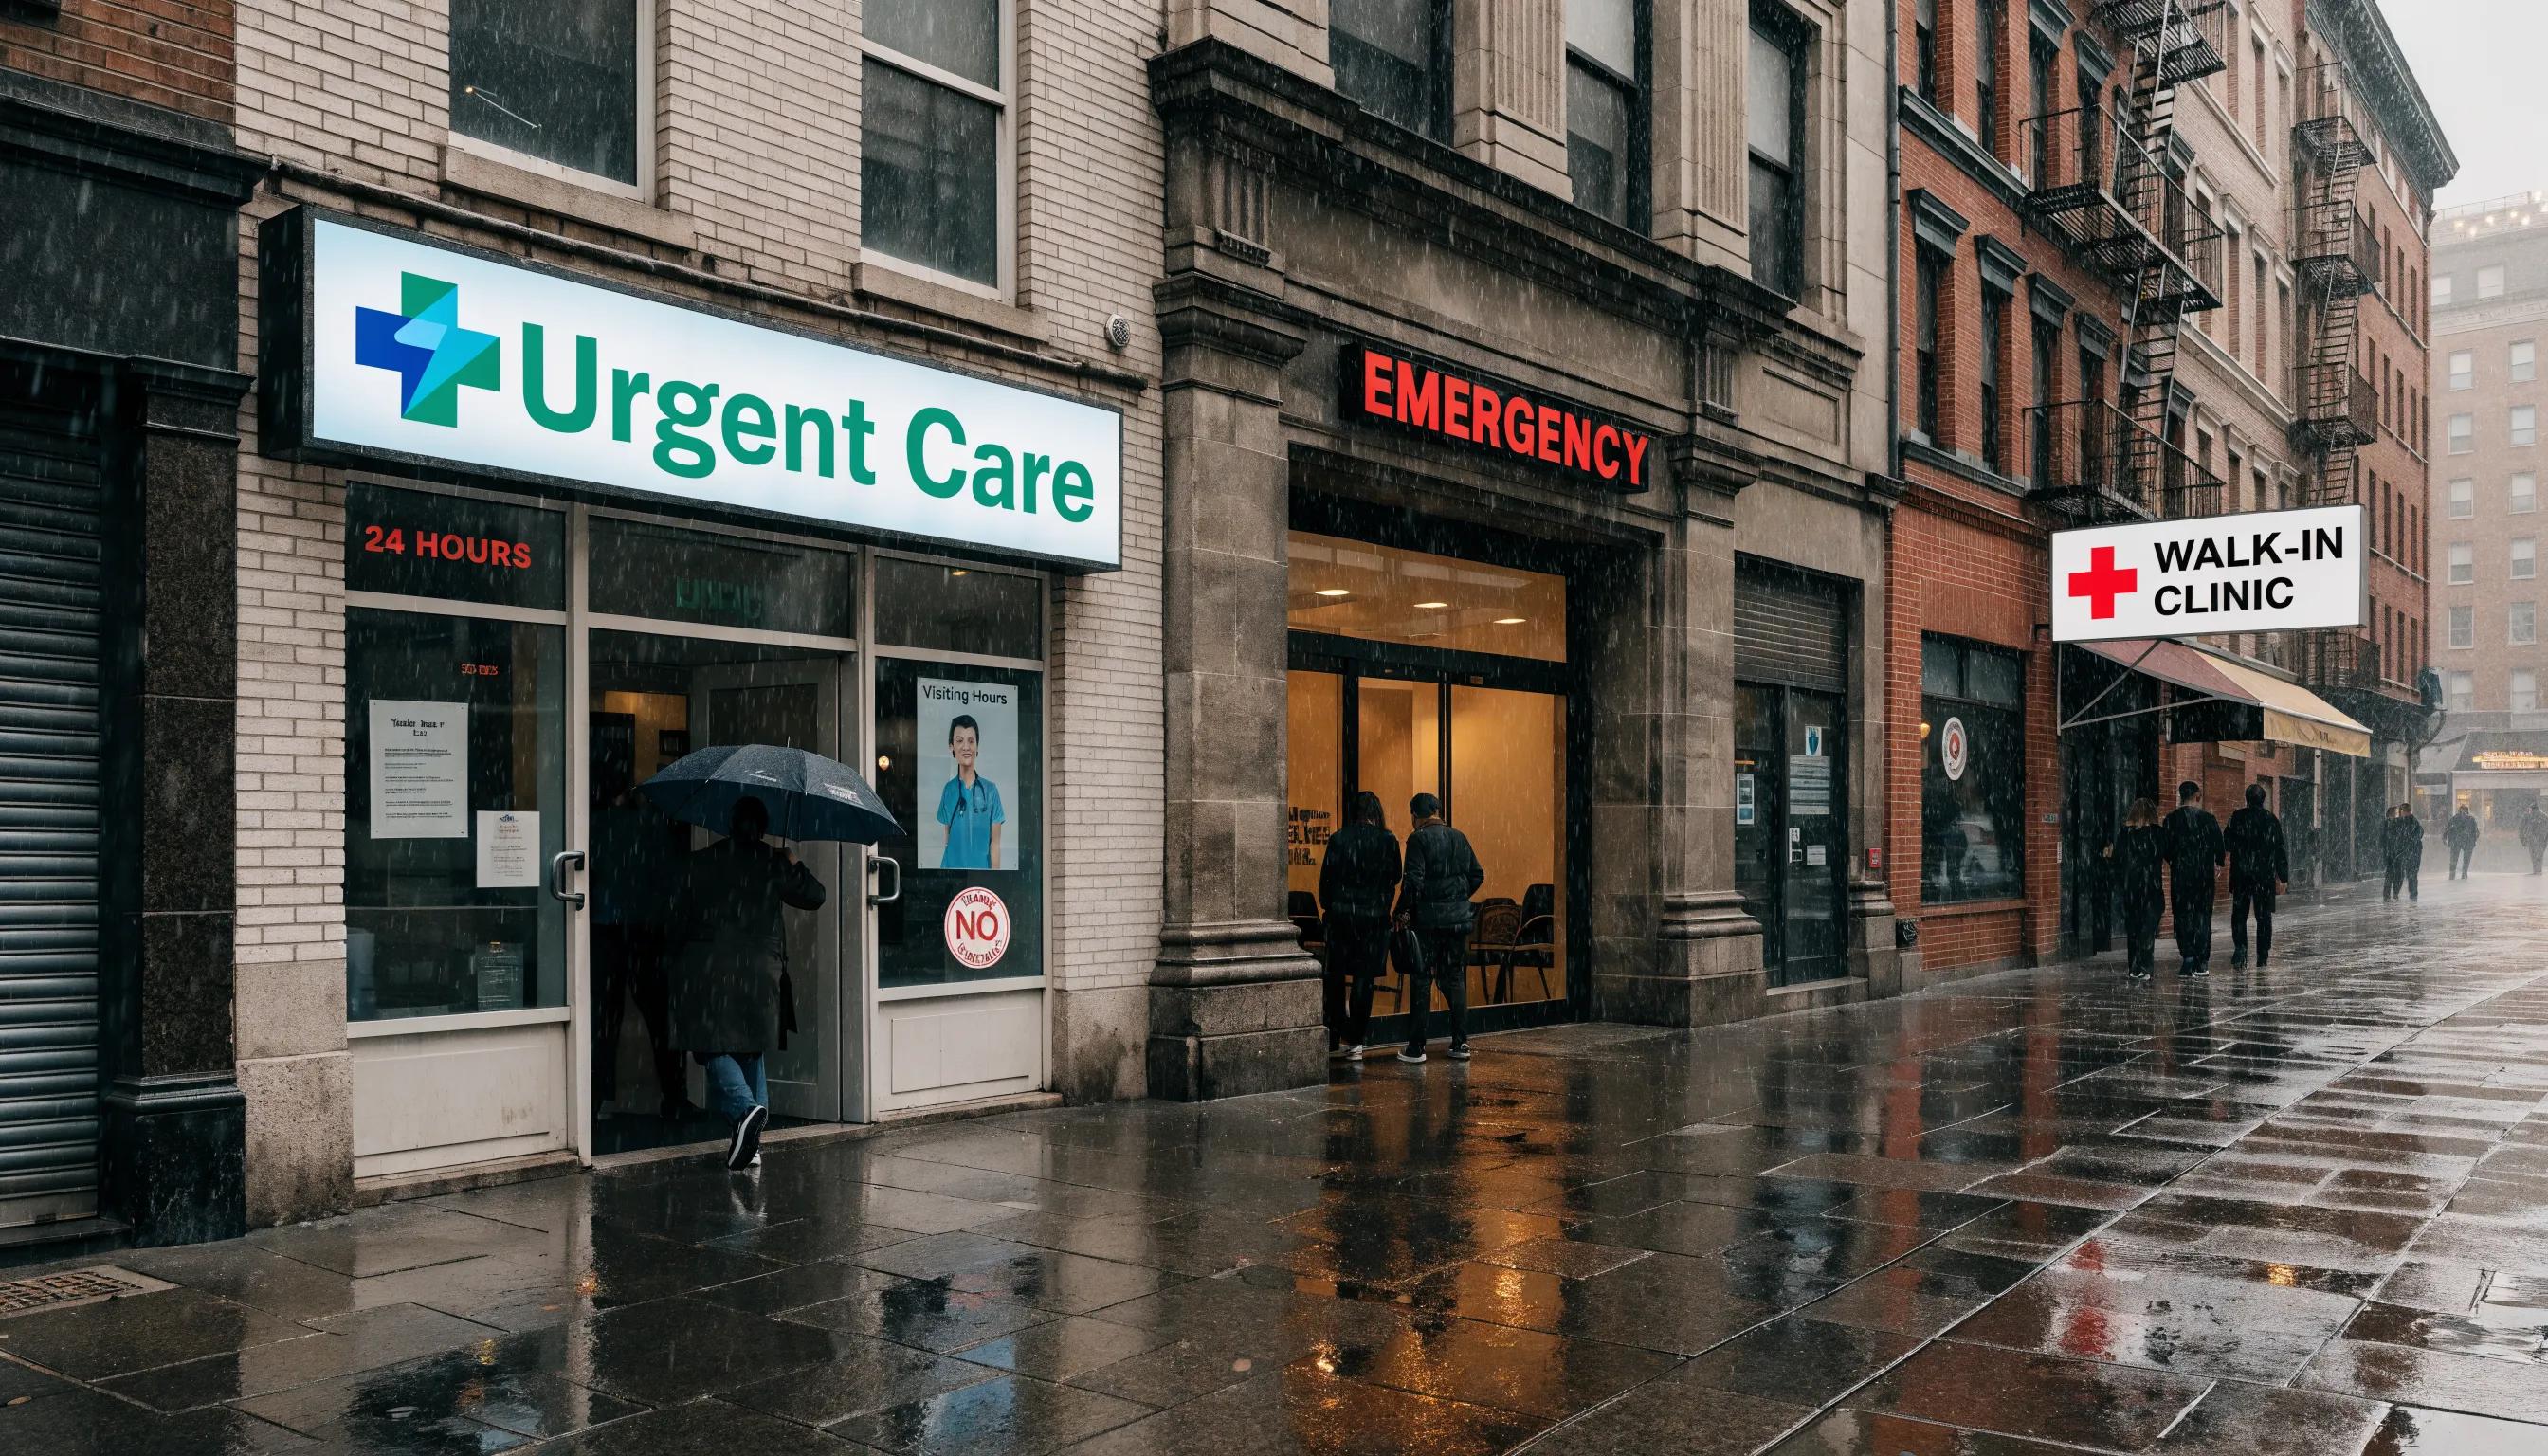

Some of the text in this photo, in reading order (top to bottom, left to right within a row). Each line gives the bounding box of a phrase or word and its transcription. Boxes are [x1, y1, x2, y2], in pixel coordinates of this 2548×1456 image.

[522, 321, 1094, 523] Urgent Care
[1364, 350, 1648, 485] EMERGENCY
[364, 525, 532, 569] 24 HOURS
[2153, 526, 2343, 573] WALK-IN
[2154, 576, 2294, 616] CLINIC
[922, 684, 1008, 705] Visiting Hours
[956, 909, 999, 941] NO
